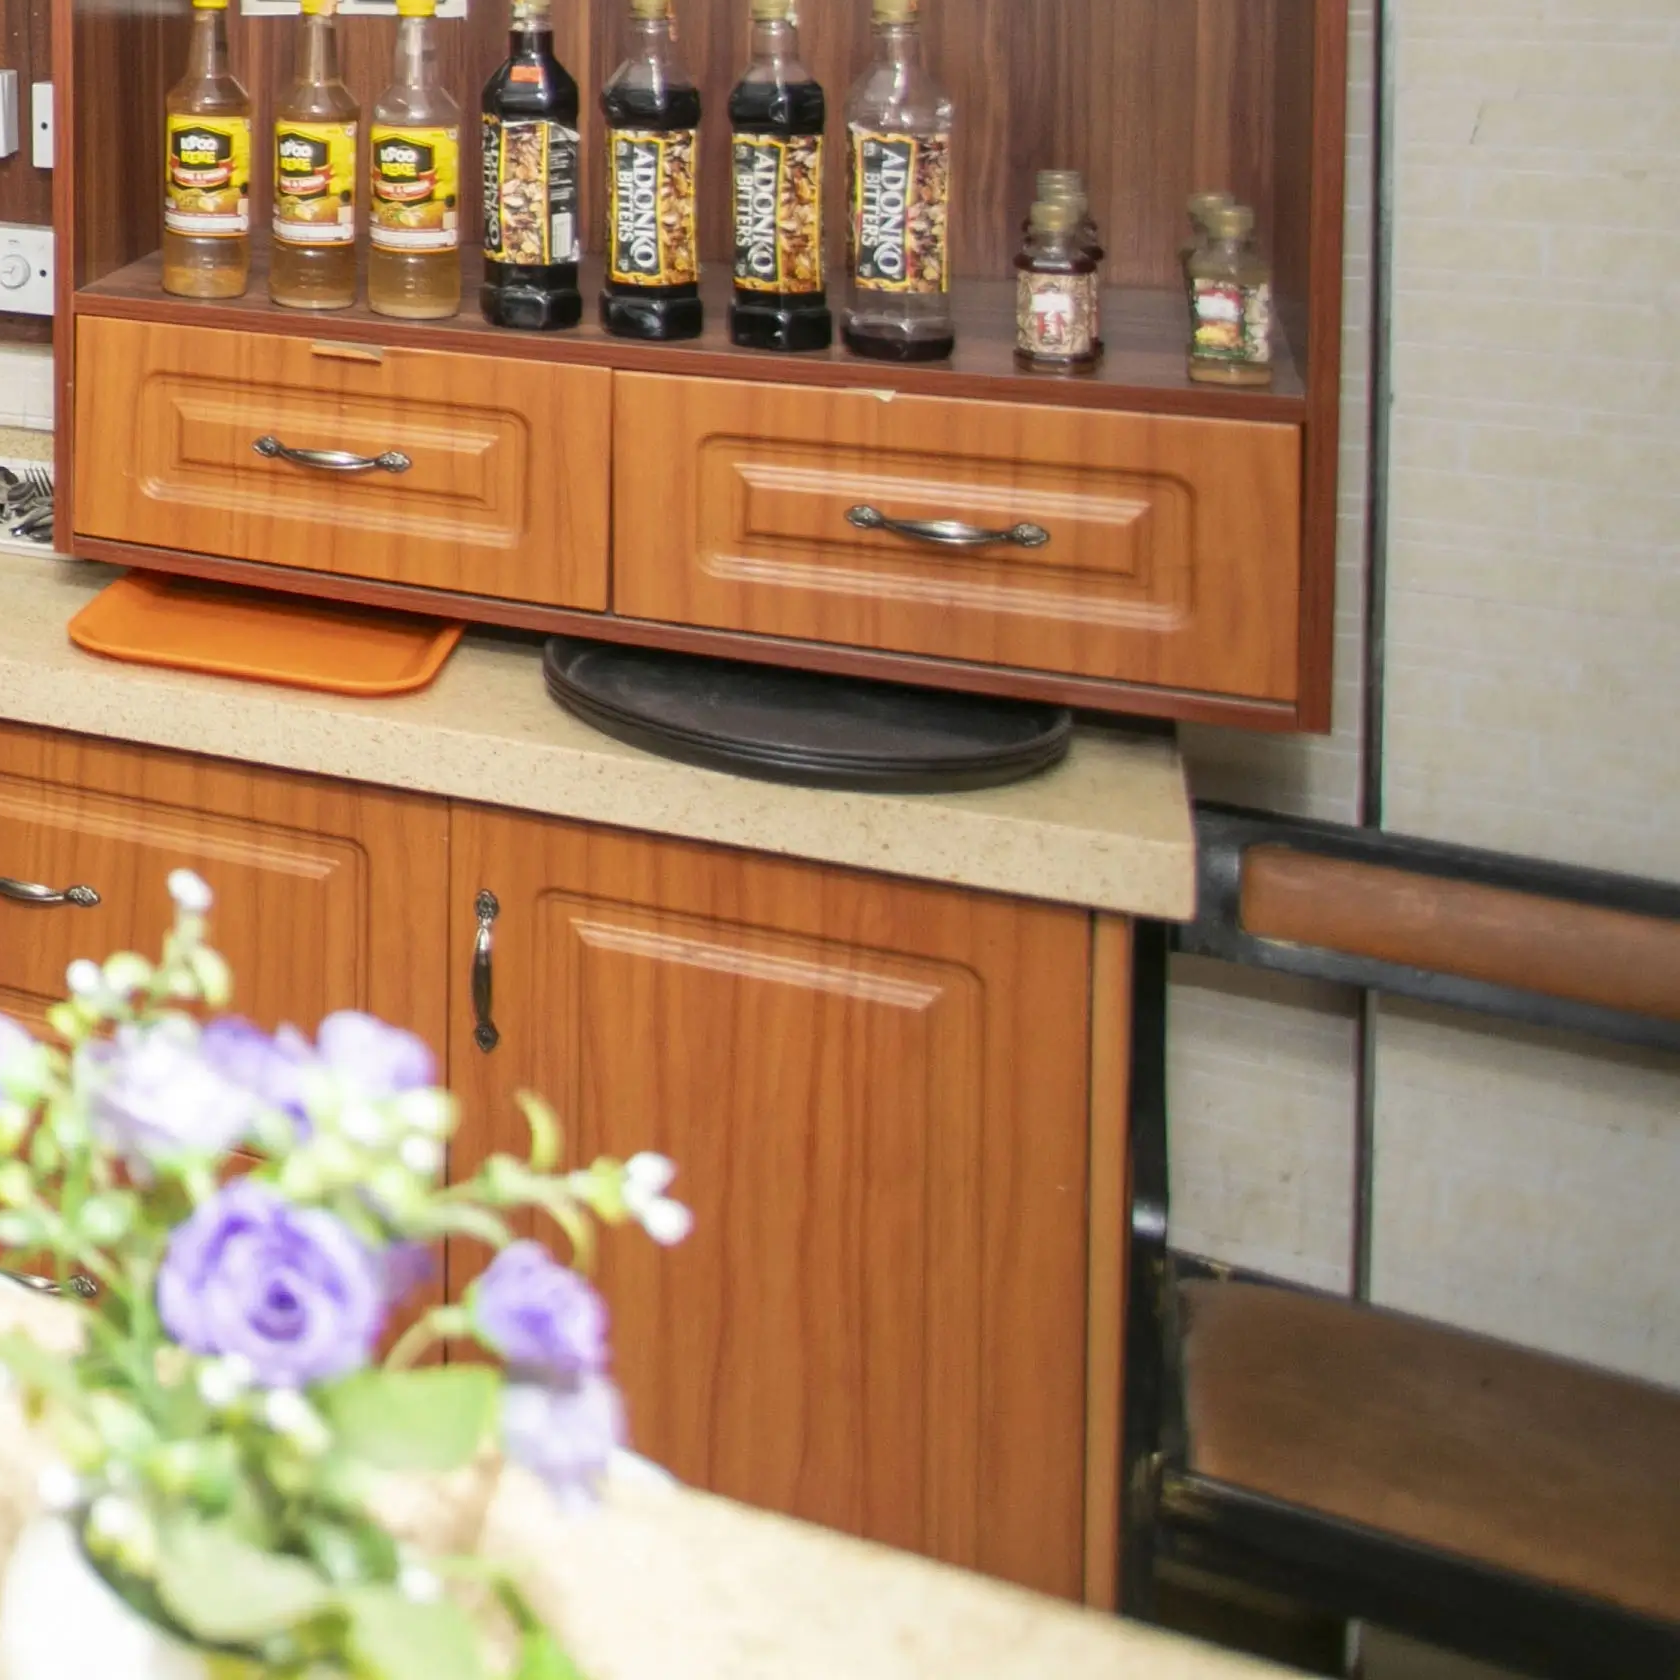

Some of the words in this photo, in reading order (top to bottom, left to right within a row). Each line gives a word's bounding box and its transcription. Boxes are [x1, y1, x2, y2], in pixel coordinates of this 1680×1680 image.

[617, 169, 634, 243] BITTERS
[630, 146, 657, 268] ADONKO
[734, 173, 753, 247] BITTERS
[750, 151, 776, 275] ADONKO
[860, 170, 881, 247] BITTERS
[875, 147, 907, 276] ADONKO
